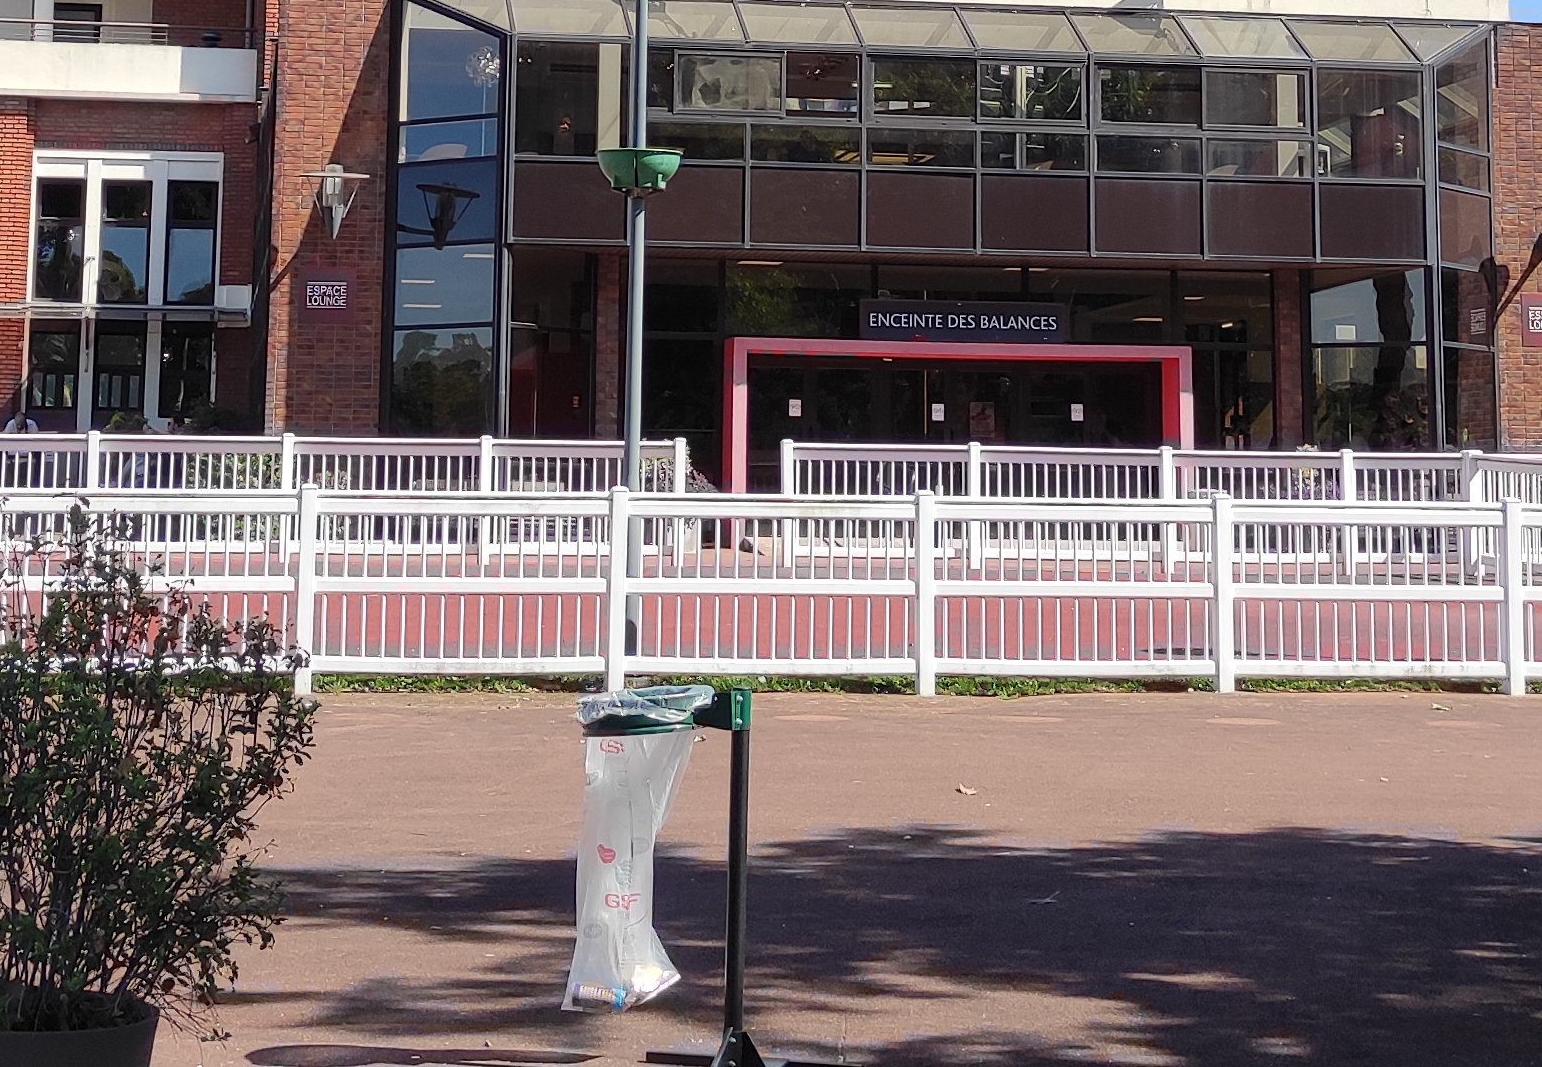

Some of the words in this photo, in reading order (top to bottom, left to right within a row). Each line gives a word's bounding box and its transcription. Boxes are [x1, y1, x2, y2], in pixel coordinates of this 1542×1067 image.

[307, 285, 347, 295] ESPACE
[307, 296, 347, 306] LOUNGE
[869, 312, 944, 329] ENCEINTE
[947, 314, 977, 330] DES
[979, 315, 1058, 332] BALANCES
